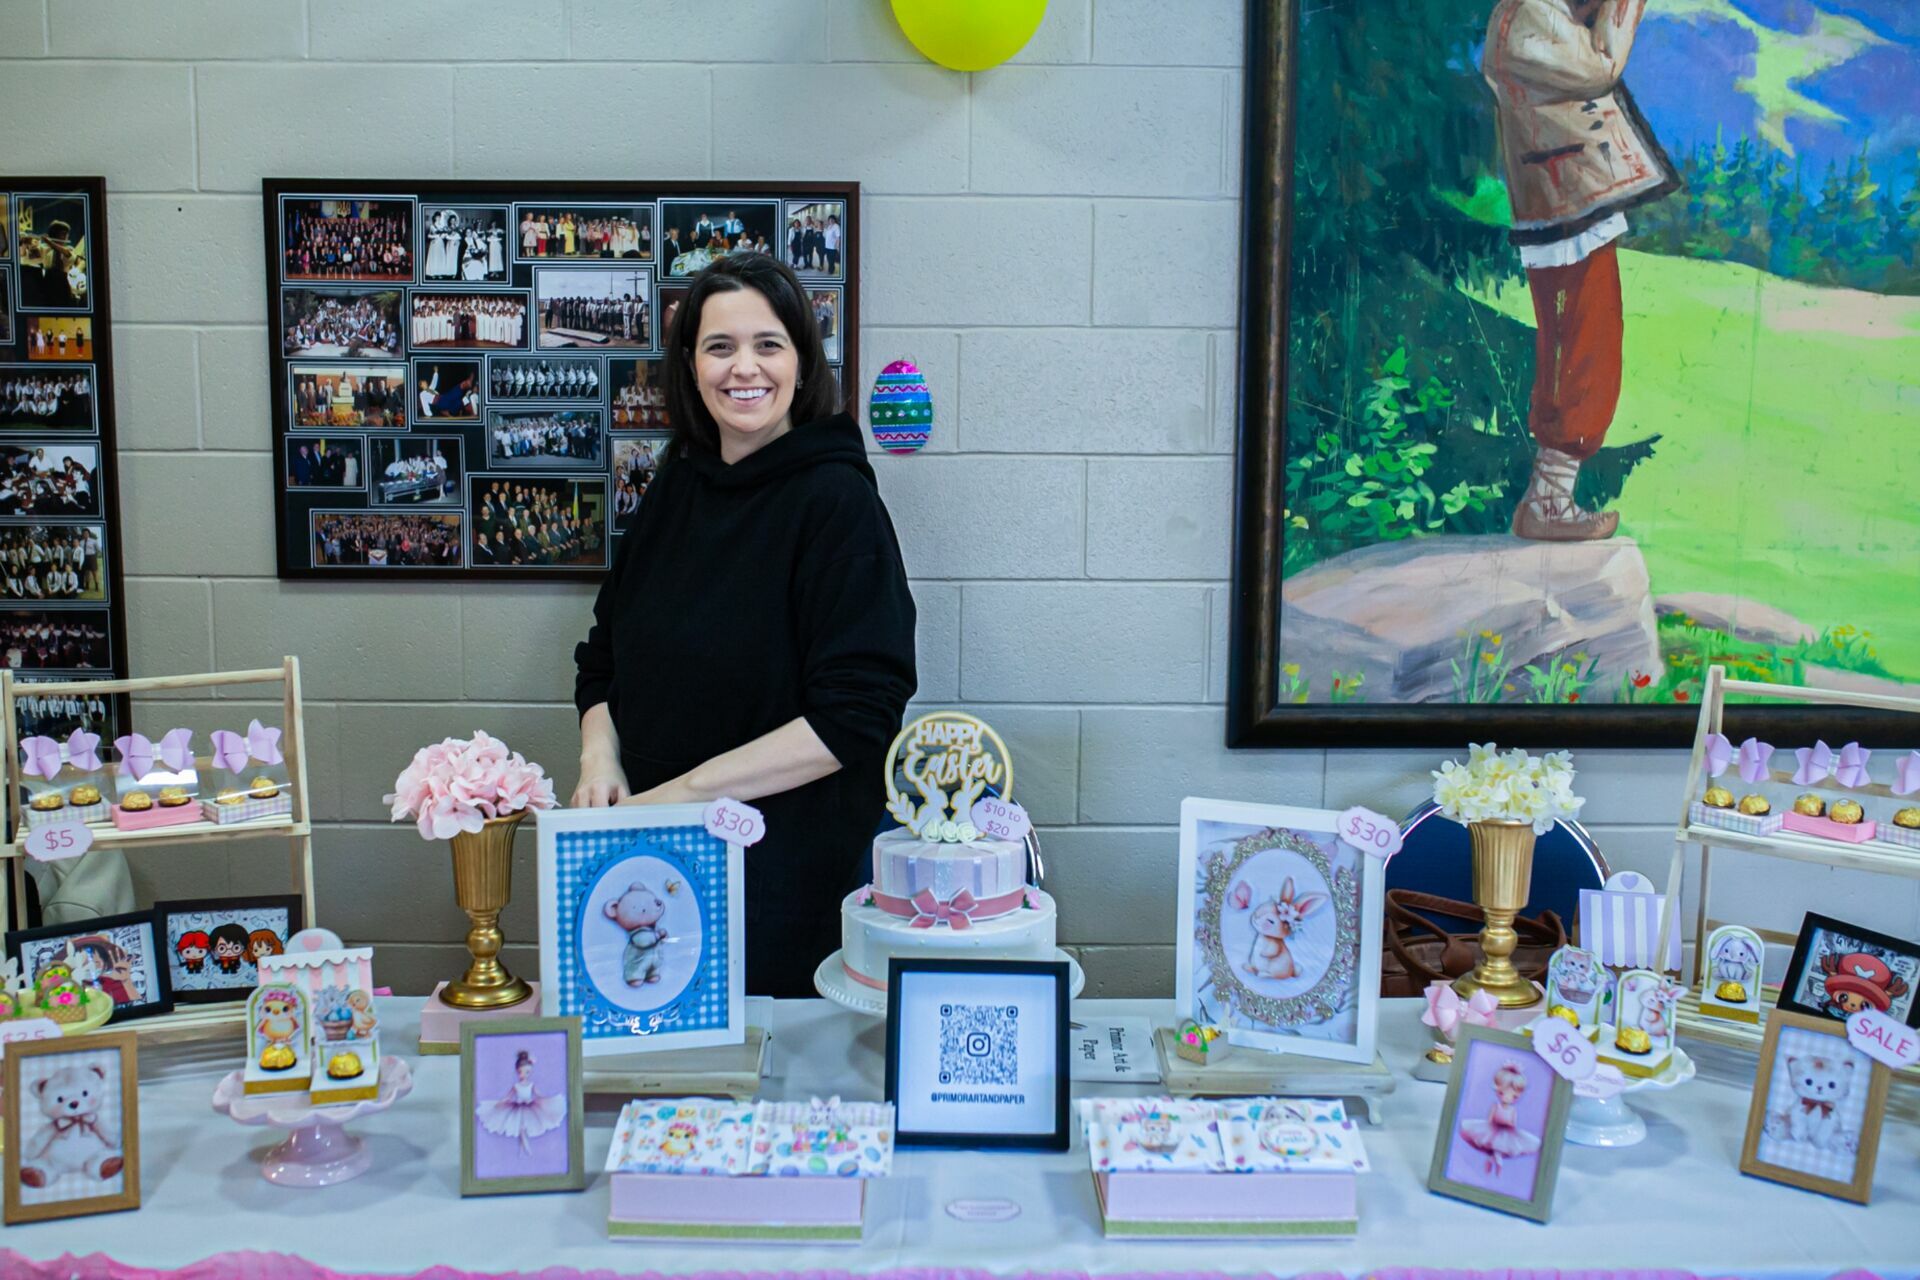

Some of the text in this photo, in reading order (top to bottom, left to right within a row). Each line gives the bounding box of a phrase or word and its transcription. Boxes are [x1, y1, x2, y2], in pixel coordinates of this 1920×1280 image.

[916, 722, 983, 753] HAPPY
[904, 739, 1002, 785] Easter
[712, 806, 754, 837] $30
[984, 802, 1021, 823] $10 to
[45, 829, 74, 851] $5
[987, 820, 1010, 837] $20
[1347, 816, 1391, 848] $30
[1078, 1039, 1098, 1060] Paper
[1547, 1032, 1582, 1065] $6
[1855, 1017, 1913, 1058] SALE
[930, 1092, 1025, 1104] @PRIMORARTANDPAPER
